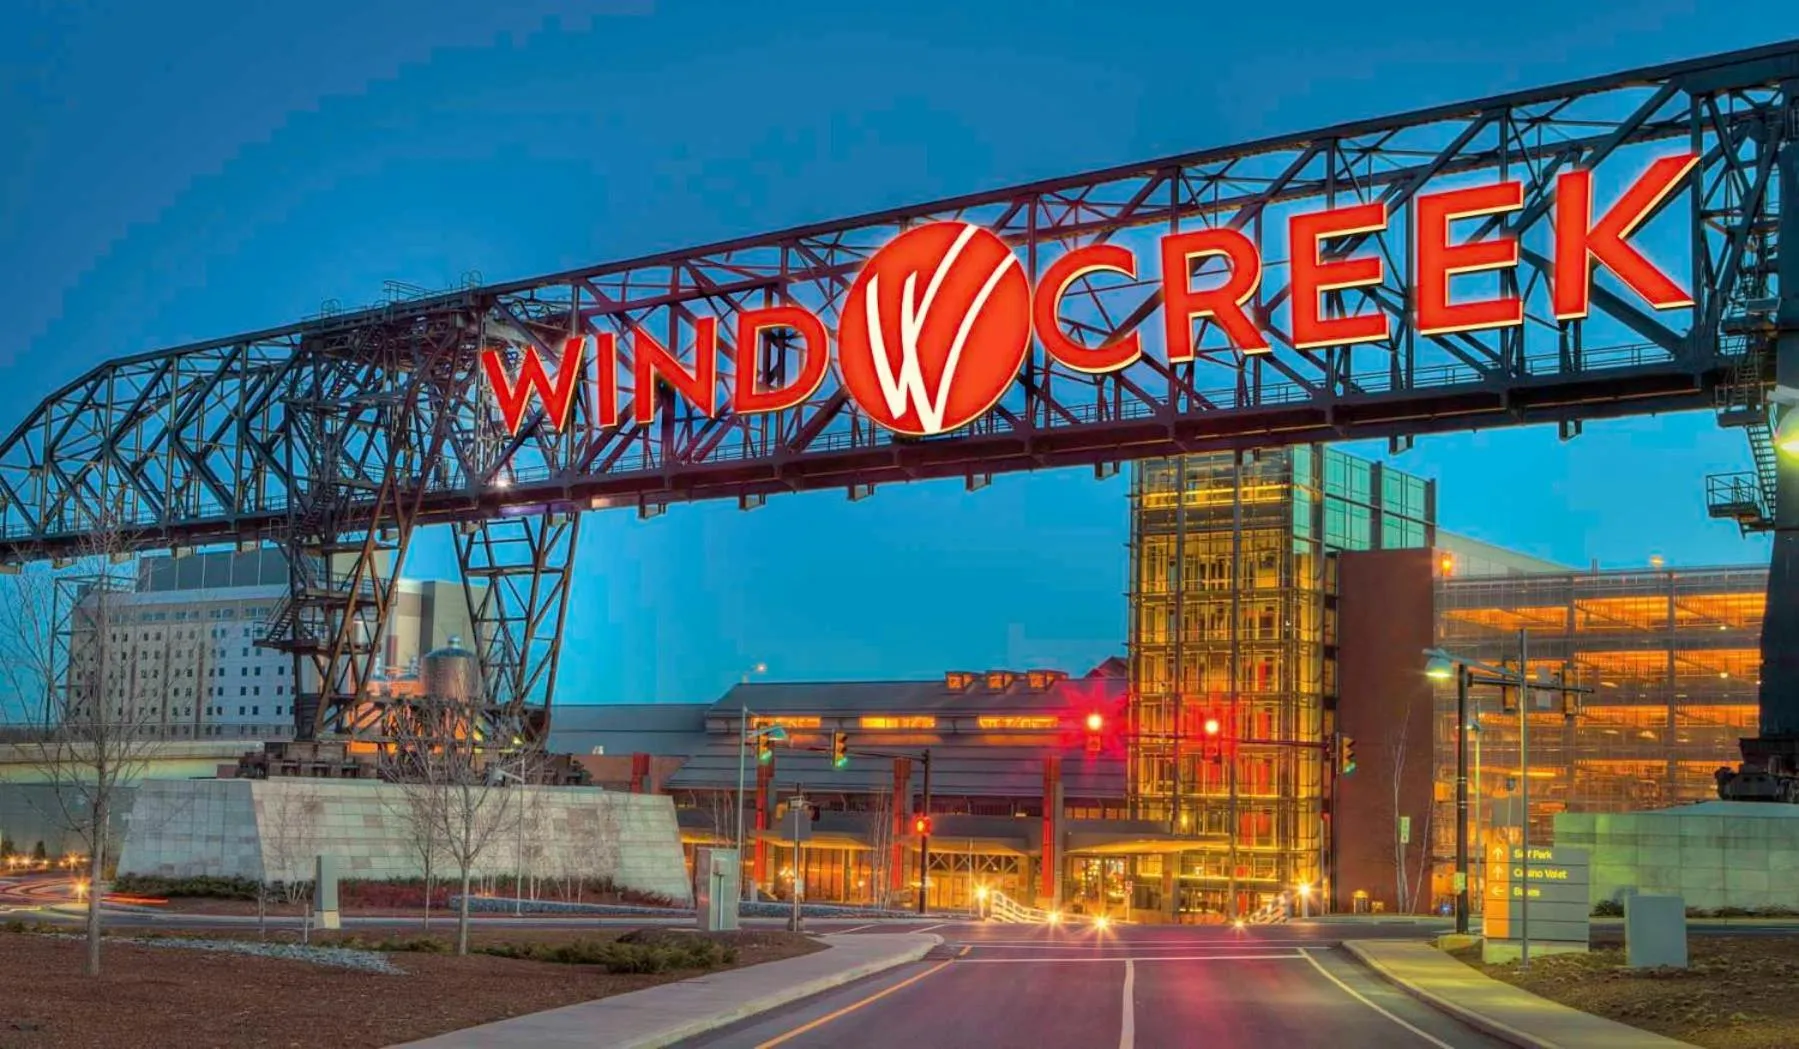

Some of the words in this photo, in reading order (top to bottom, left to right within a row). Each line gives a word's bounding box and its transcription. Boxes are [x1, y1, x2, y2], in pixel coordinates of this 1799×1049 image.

[481, 306, 830, 437] WIND
[1032, 152, 1700, 374] CREEK
[1533, 849, 1552, 860] Park
